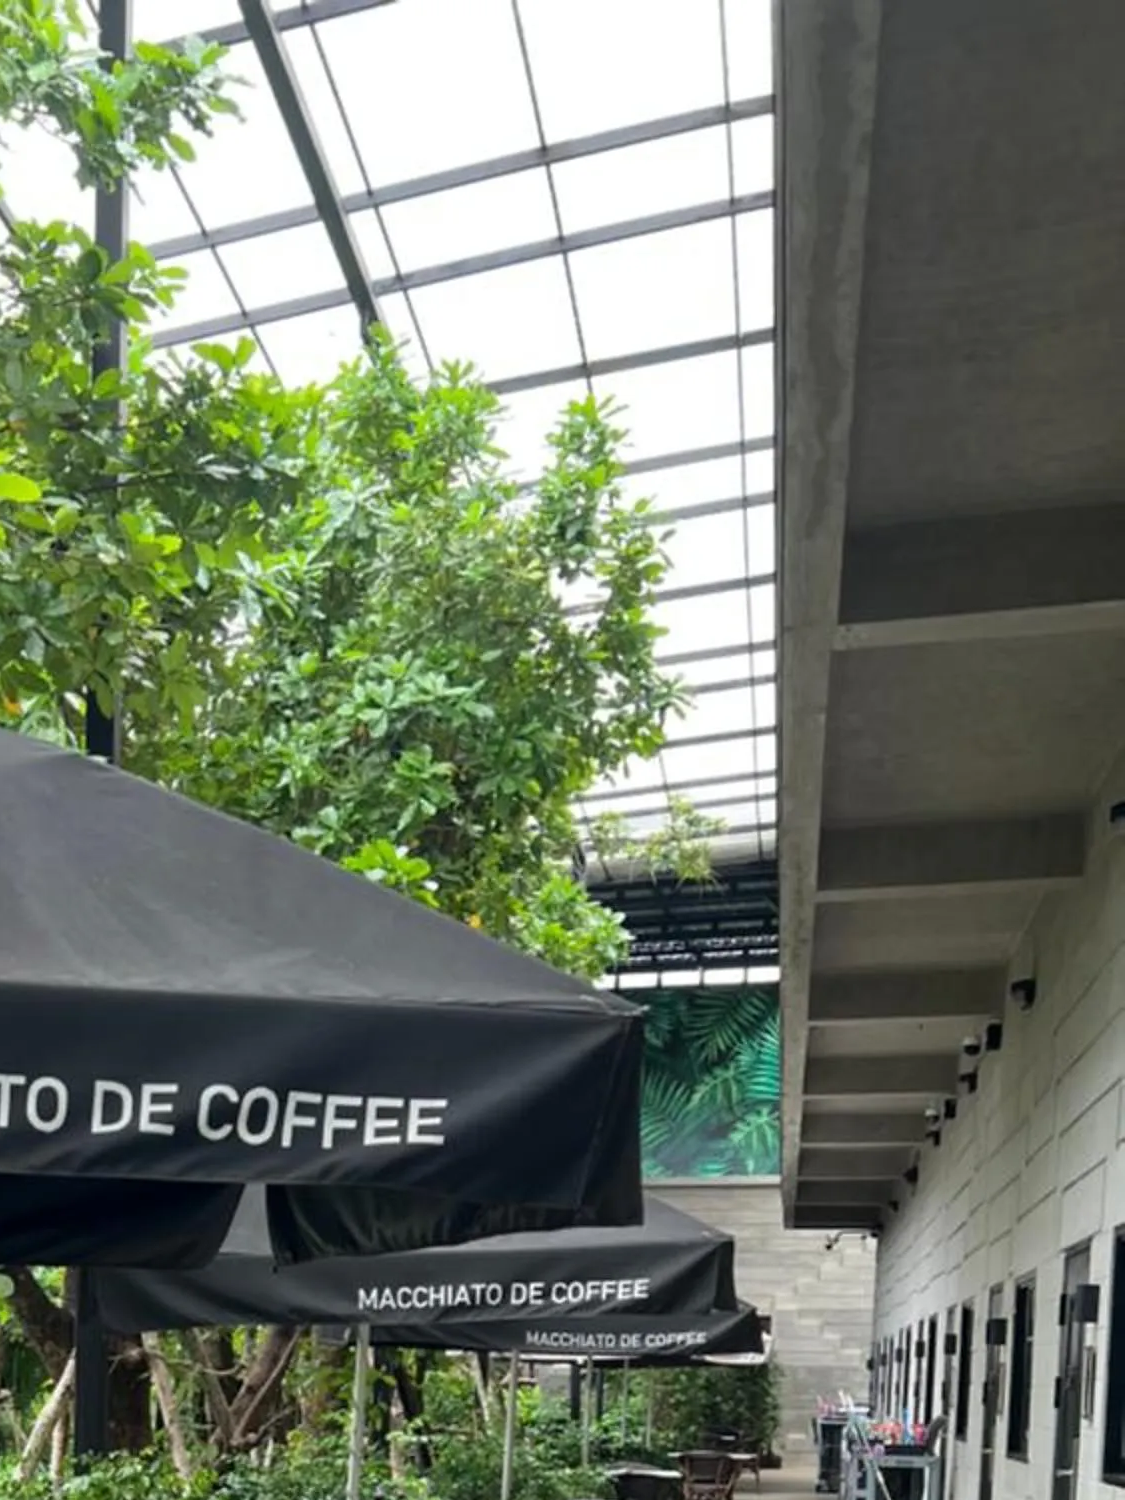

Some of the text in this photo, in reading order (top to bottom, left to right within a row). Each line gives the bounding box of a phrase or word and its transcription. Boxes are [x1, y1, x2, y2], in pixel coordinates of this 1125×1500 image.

[90, 1080, 179, 1135] DE
[197, 1084, 449, 1149] COFFEE
[358, 1277, 651, 1310] MACCHIATO DE COFFEE
[526, 1331, 616, 1348] MACCHIATO
[619, 1333, 642, 1347] DE
